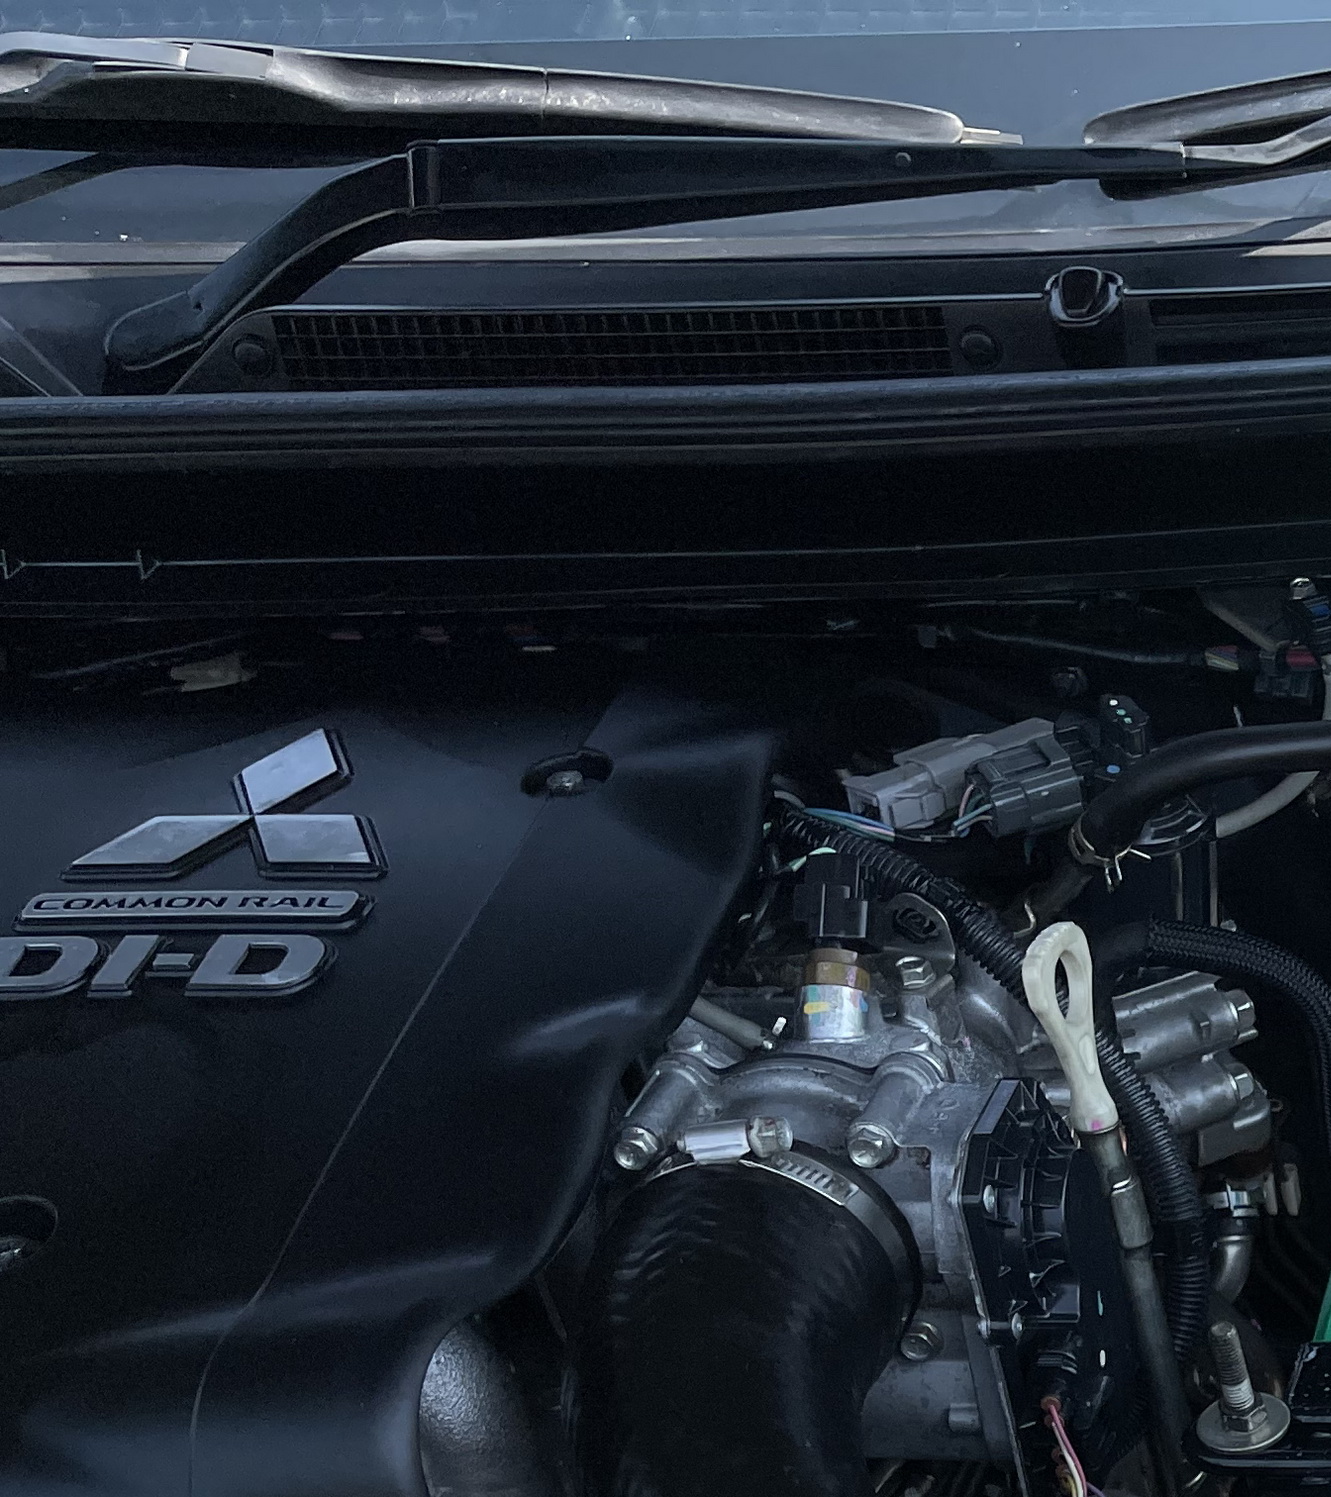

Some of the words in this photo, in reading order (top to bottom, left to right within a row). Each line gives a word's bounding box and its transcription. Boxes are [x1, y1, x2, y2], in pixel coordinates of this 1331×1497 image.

[32, 896, 228, 910] COMMON
[238, 896, 345, 909] RAIL
[0, 935, 326, 990] DI-D
